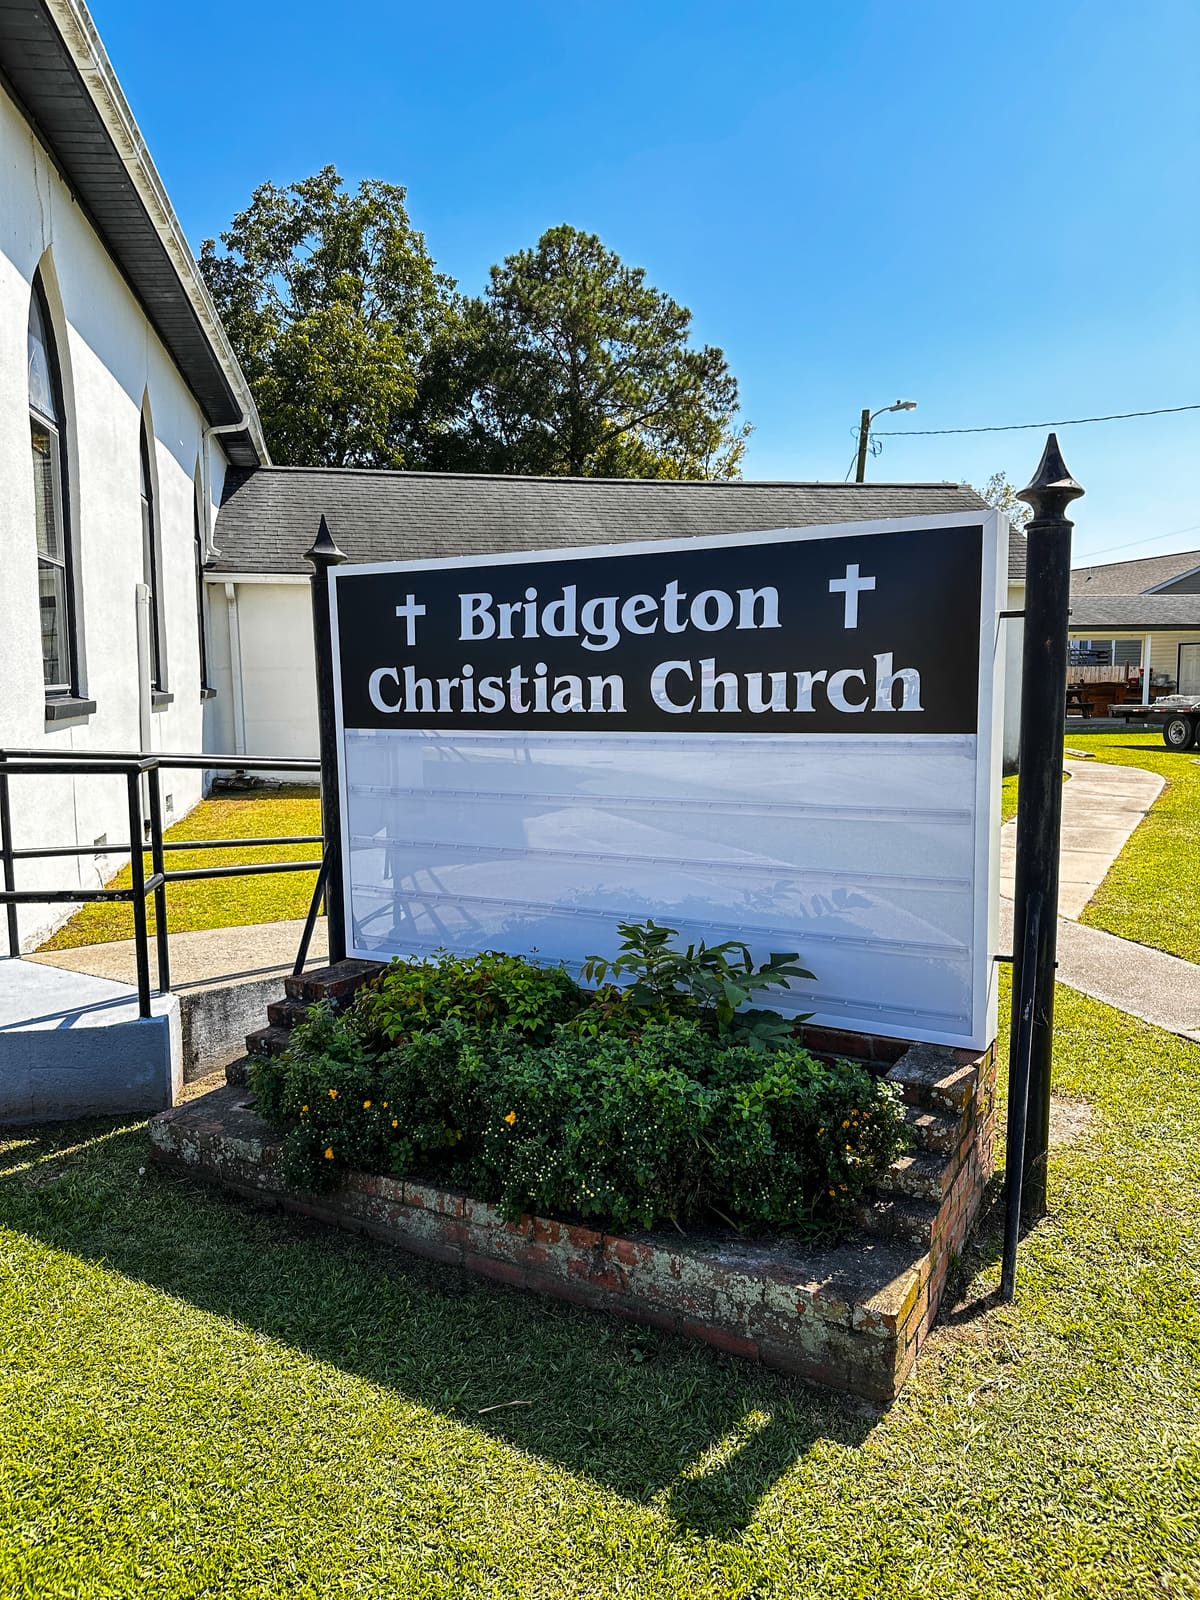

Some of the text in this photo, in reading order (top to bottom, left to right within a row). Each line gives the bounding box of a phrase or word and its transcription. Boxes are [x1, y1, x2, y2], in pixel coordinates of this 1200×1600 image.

[458, 580, 782, 651] Bridgeton
[368, 652, 925, 714] Christian Church
